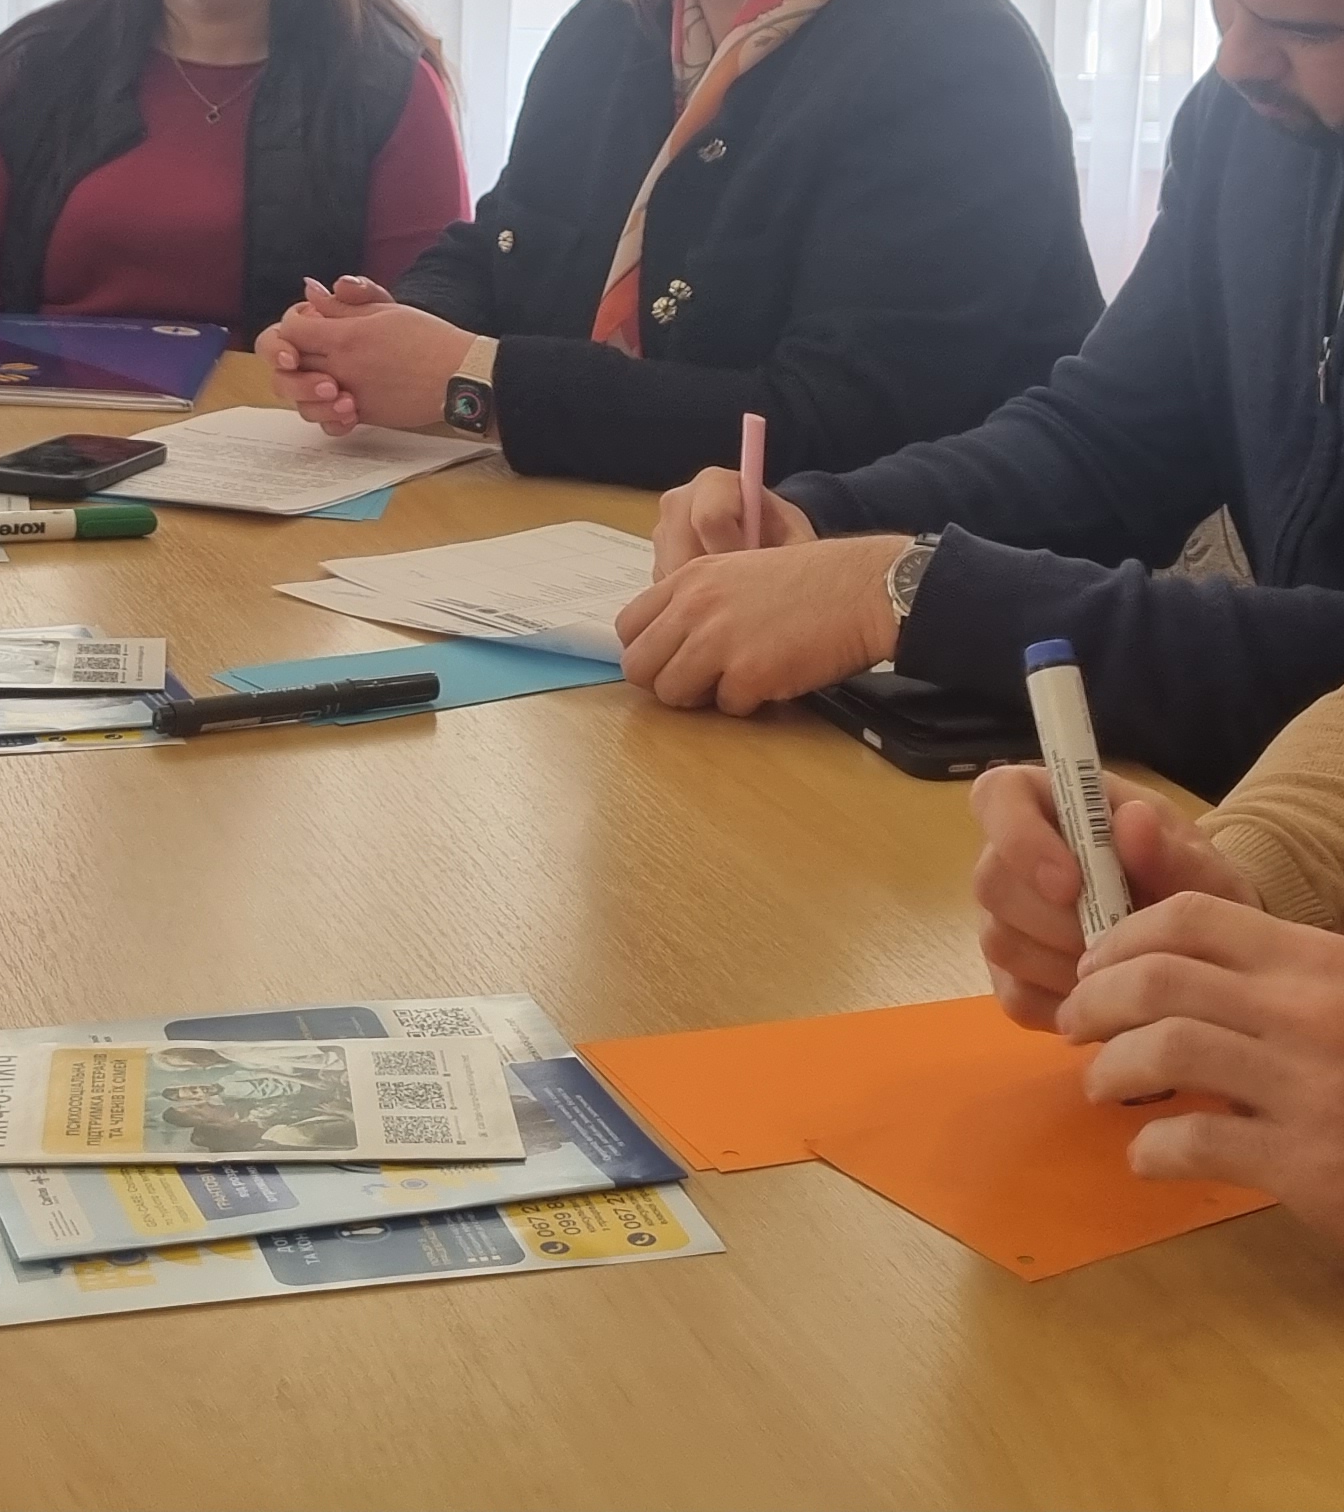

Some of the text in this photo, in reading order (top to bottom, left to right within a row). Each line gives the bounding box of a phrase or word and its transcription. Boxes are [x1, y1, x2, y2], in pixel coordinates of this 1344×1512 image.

[90, 1053, 108, 1094] ВЕТЕРАНІВ
[66, 1062, 86, 1136] ПСИХОСОЦІАЛЬНА
[108, 1059, 128, 1138] ТА ЧЛЕНІВ ЇХ СІМЕЙ
[86, 1095, 104, 1146] ПІДТРИМКА
[526, 1216, 555, 1238] 067
[554, 1212, 581, 1235] 099
[614, 1208, 642, 1230] 067
[271, 1235, 294, 1253] ДОГ
[295, 1232, 321, 1266] ТА КОН
